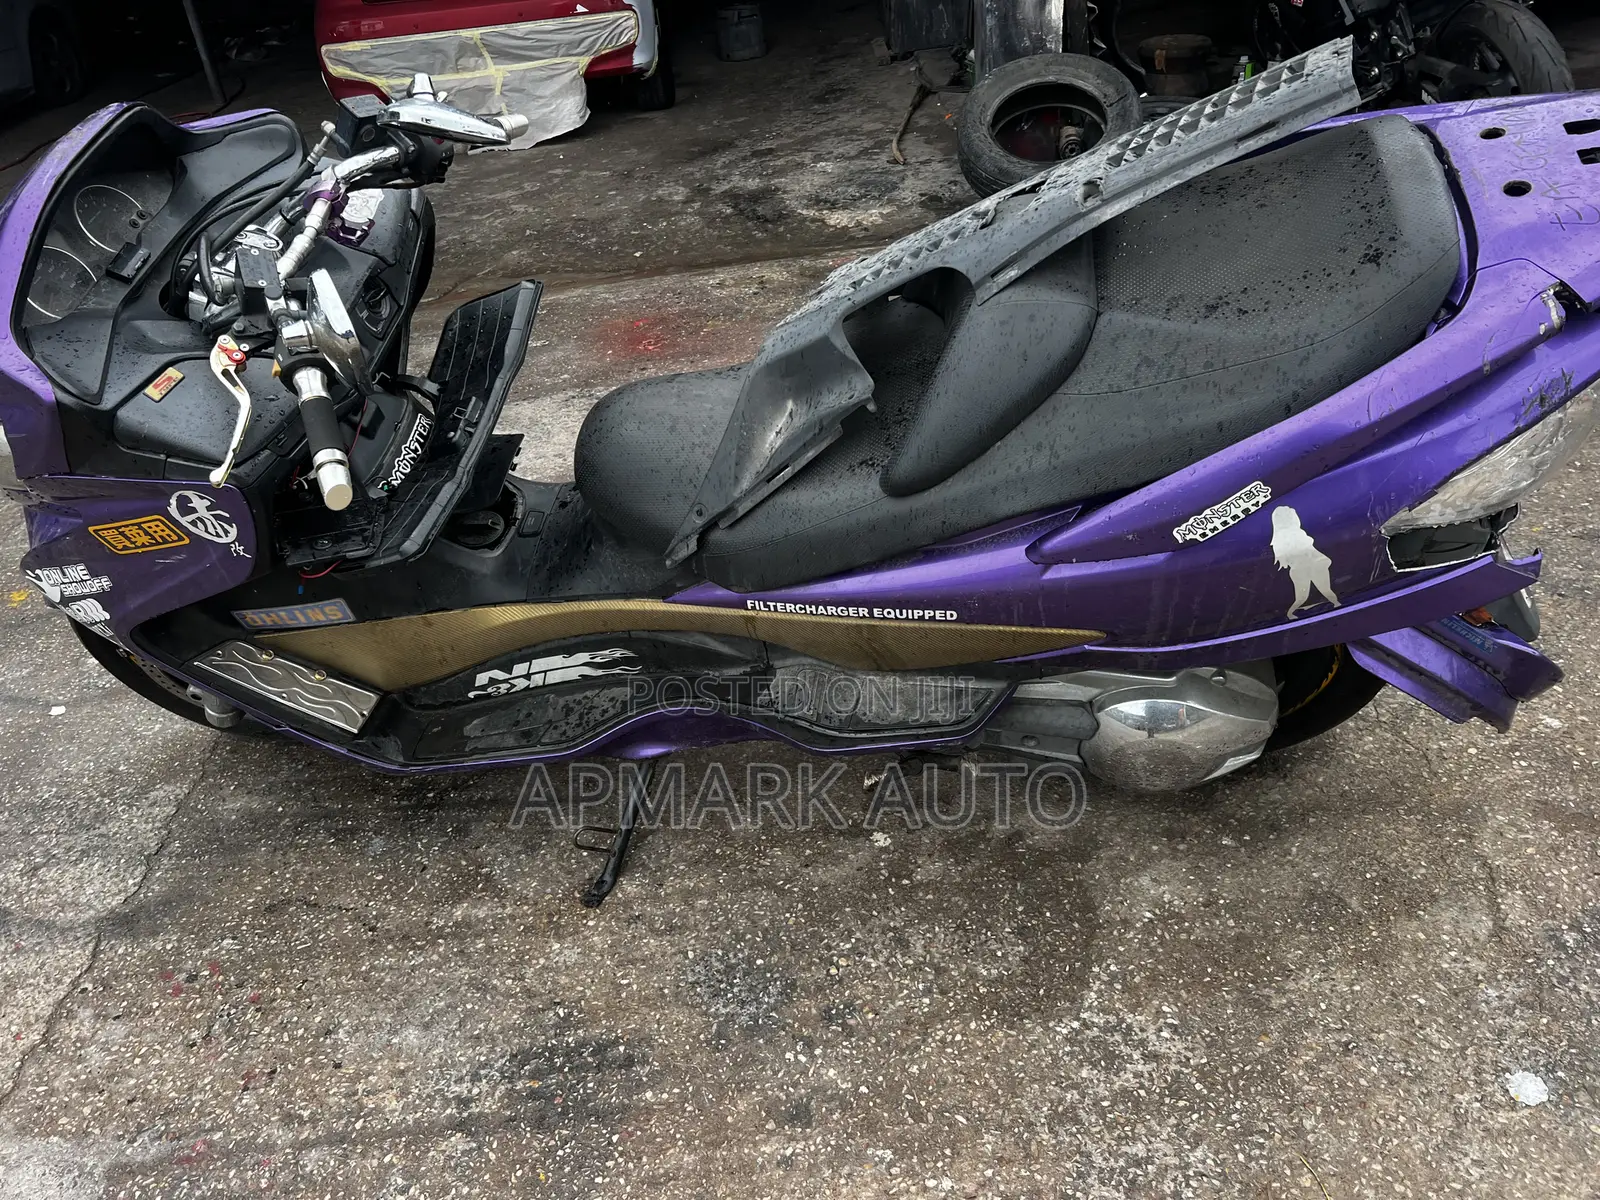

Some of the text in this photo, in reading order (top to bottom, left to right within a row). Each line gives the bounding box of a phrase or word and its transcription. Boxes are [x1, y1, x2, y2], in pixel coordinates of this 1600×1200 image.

[389, 413, 434, 487] MONSTER
[1175, 483, 1270, 541] MONSTER
[97, 520, 178, 550] 買菜用
[42, 563, 92, 586] ONLINE
[60, 576, 113, 597] SHOWOFF
[746, 599, 958, 621] FILTERCHARGER EQUIPPED
